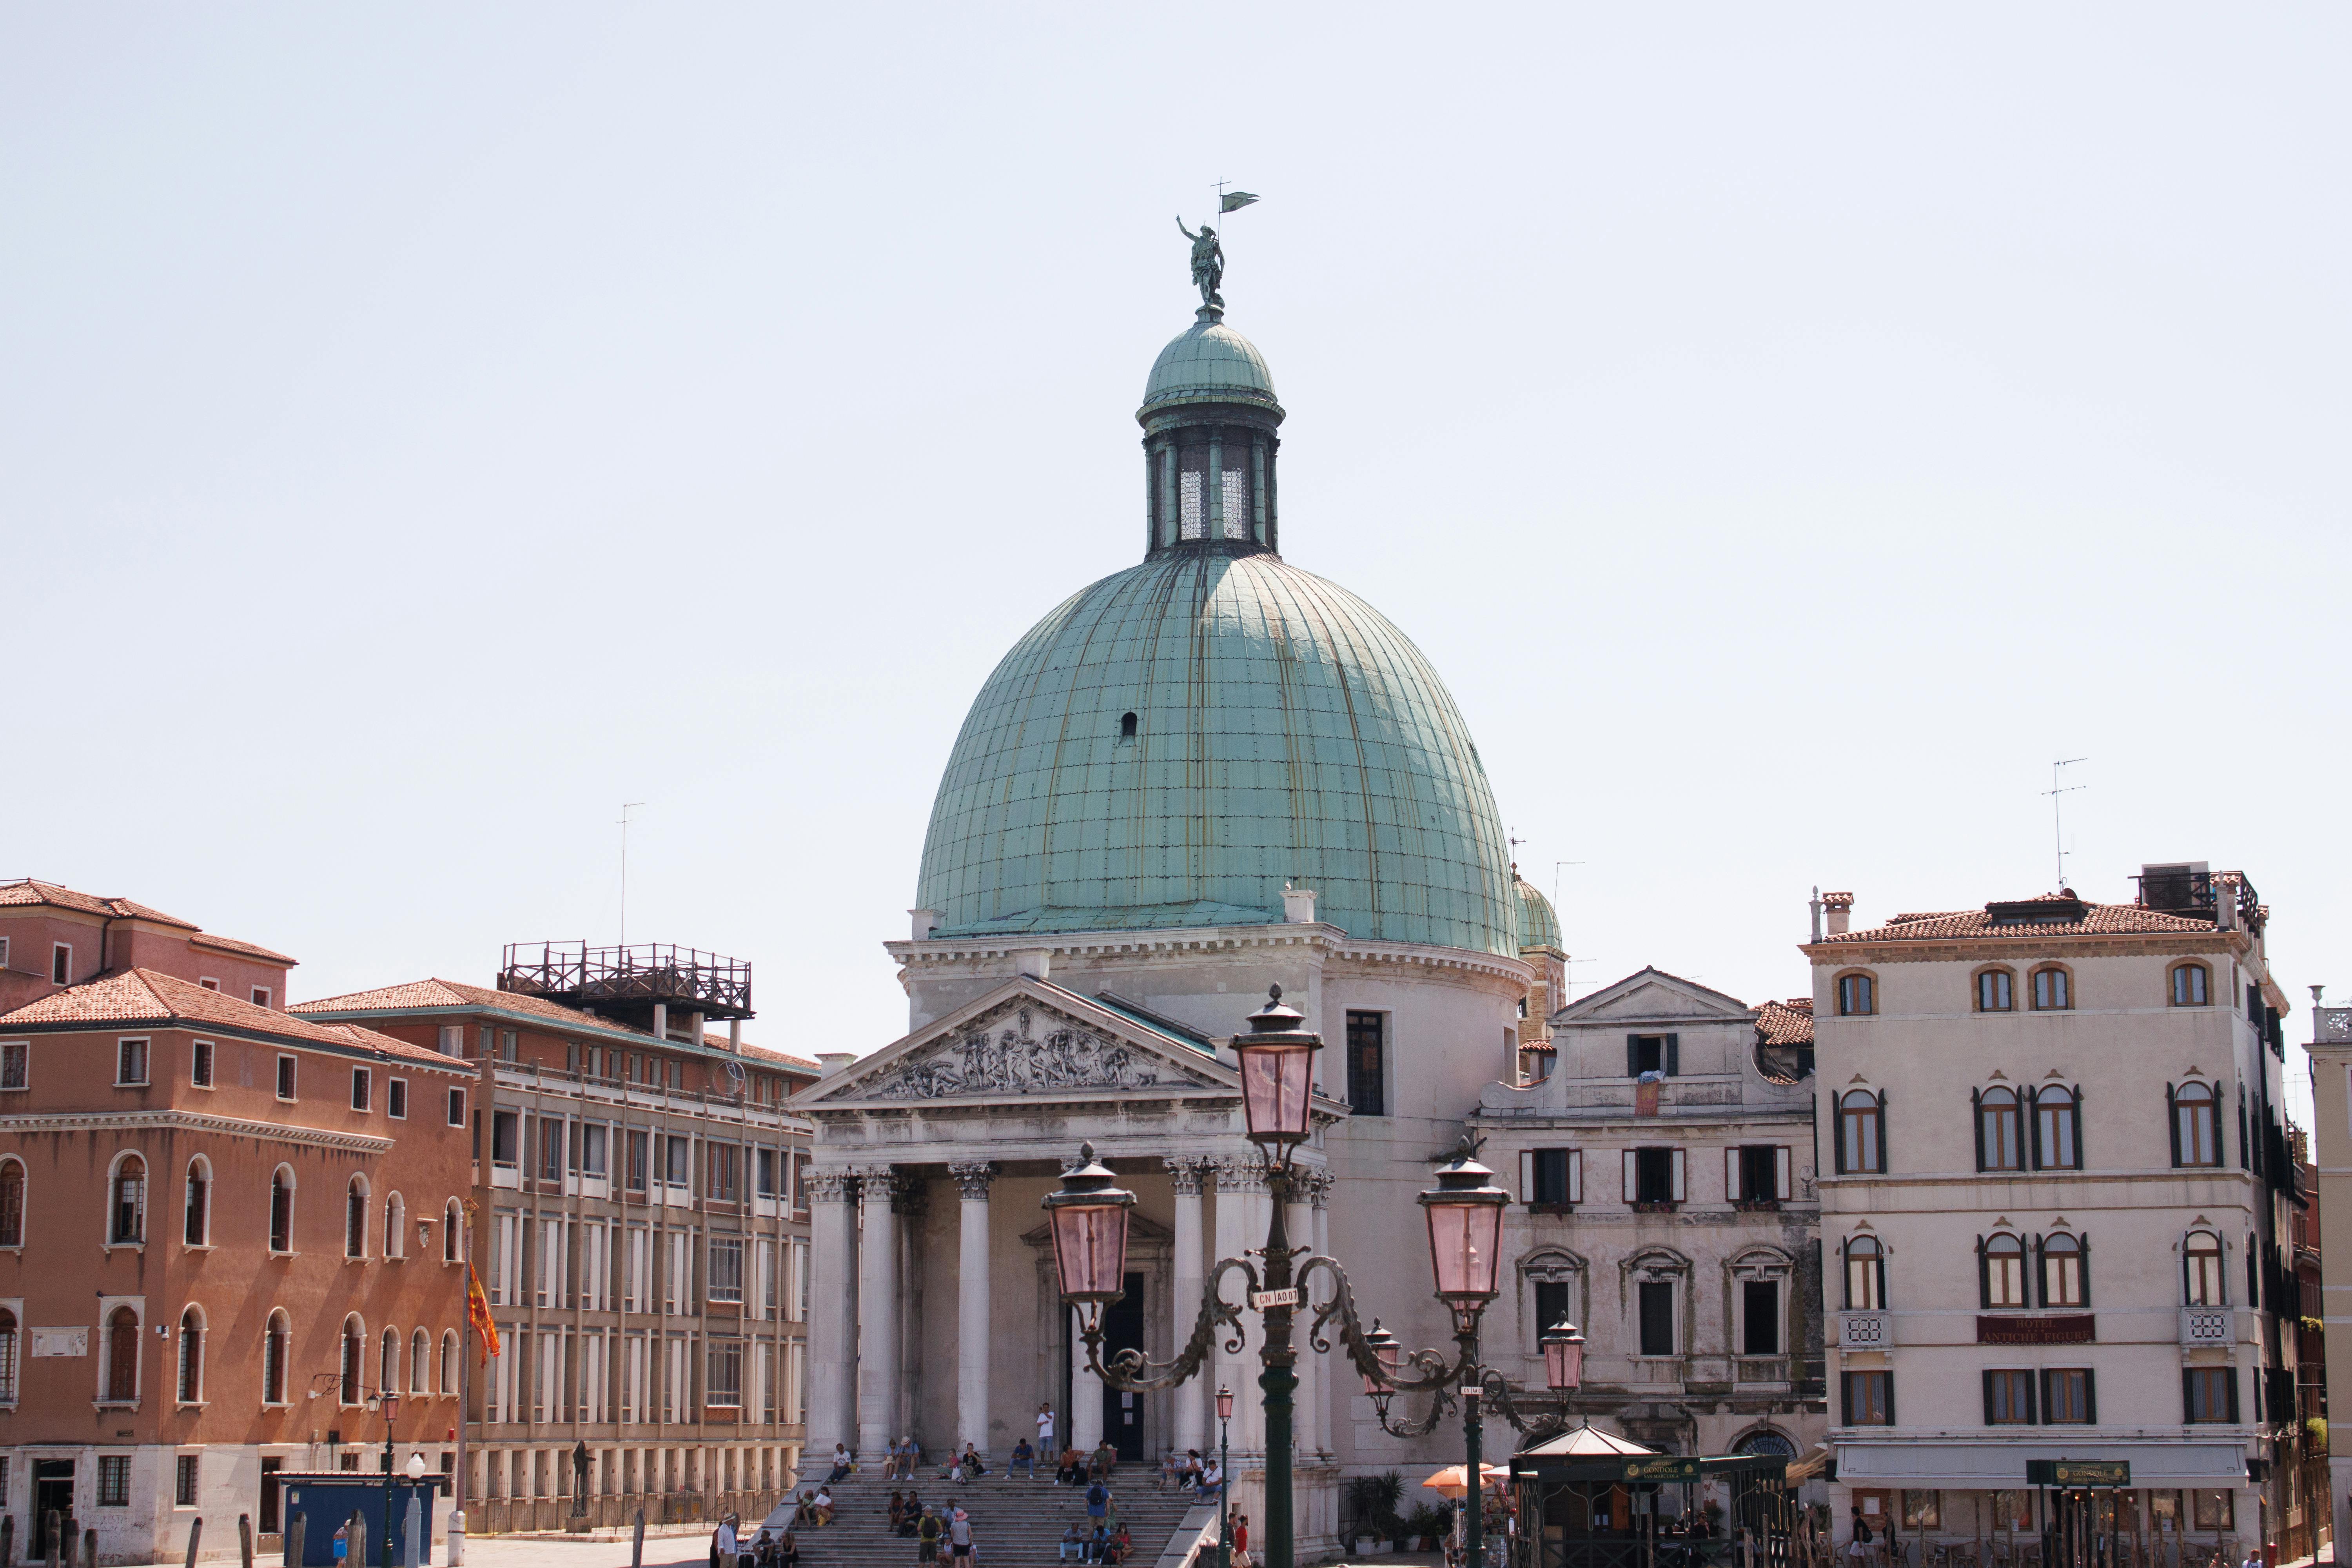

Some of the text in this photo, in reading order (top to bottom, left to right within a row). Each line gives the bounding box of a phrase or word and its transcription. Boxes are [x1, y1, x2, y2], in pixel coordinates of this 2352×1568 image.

[1259, 1294, 1271, 1304] CN
[2016, 1319, 2056, 1328] HOTEL
[1983, 1330, 2091, 1341] ANTICHE FIGURE
